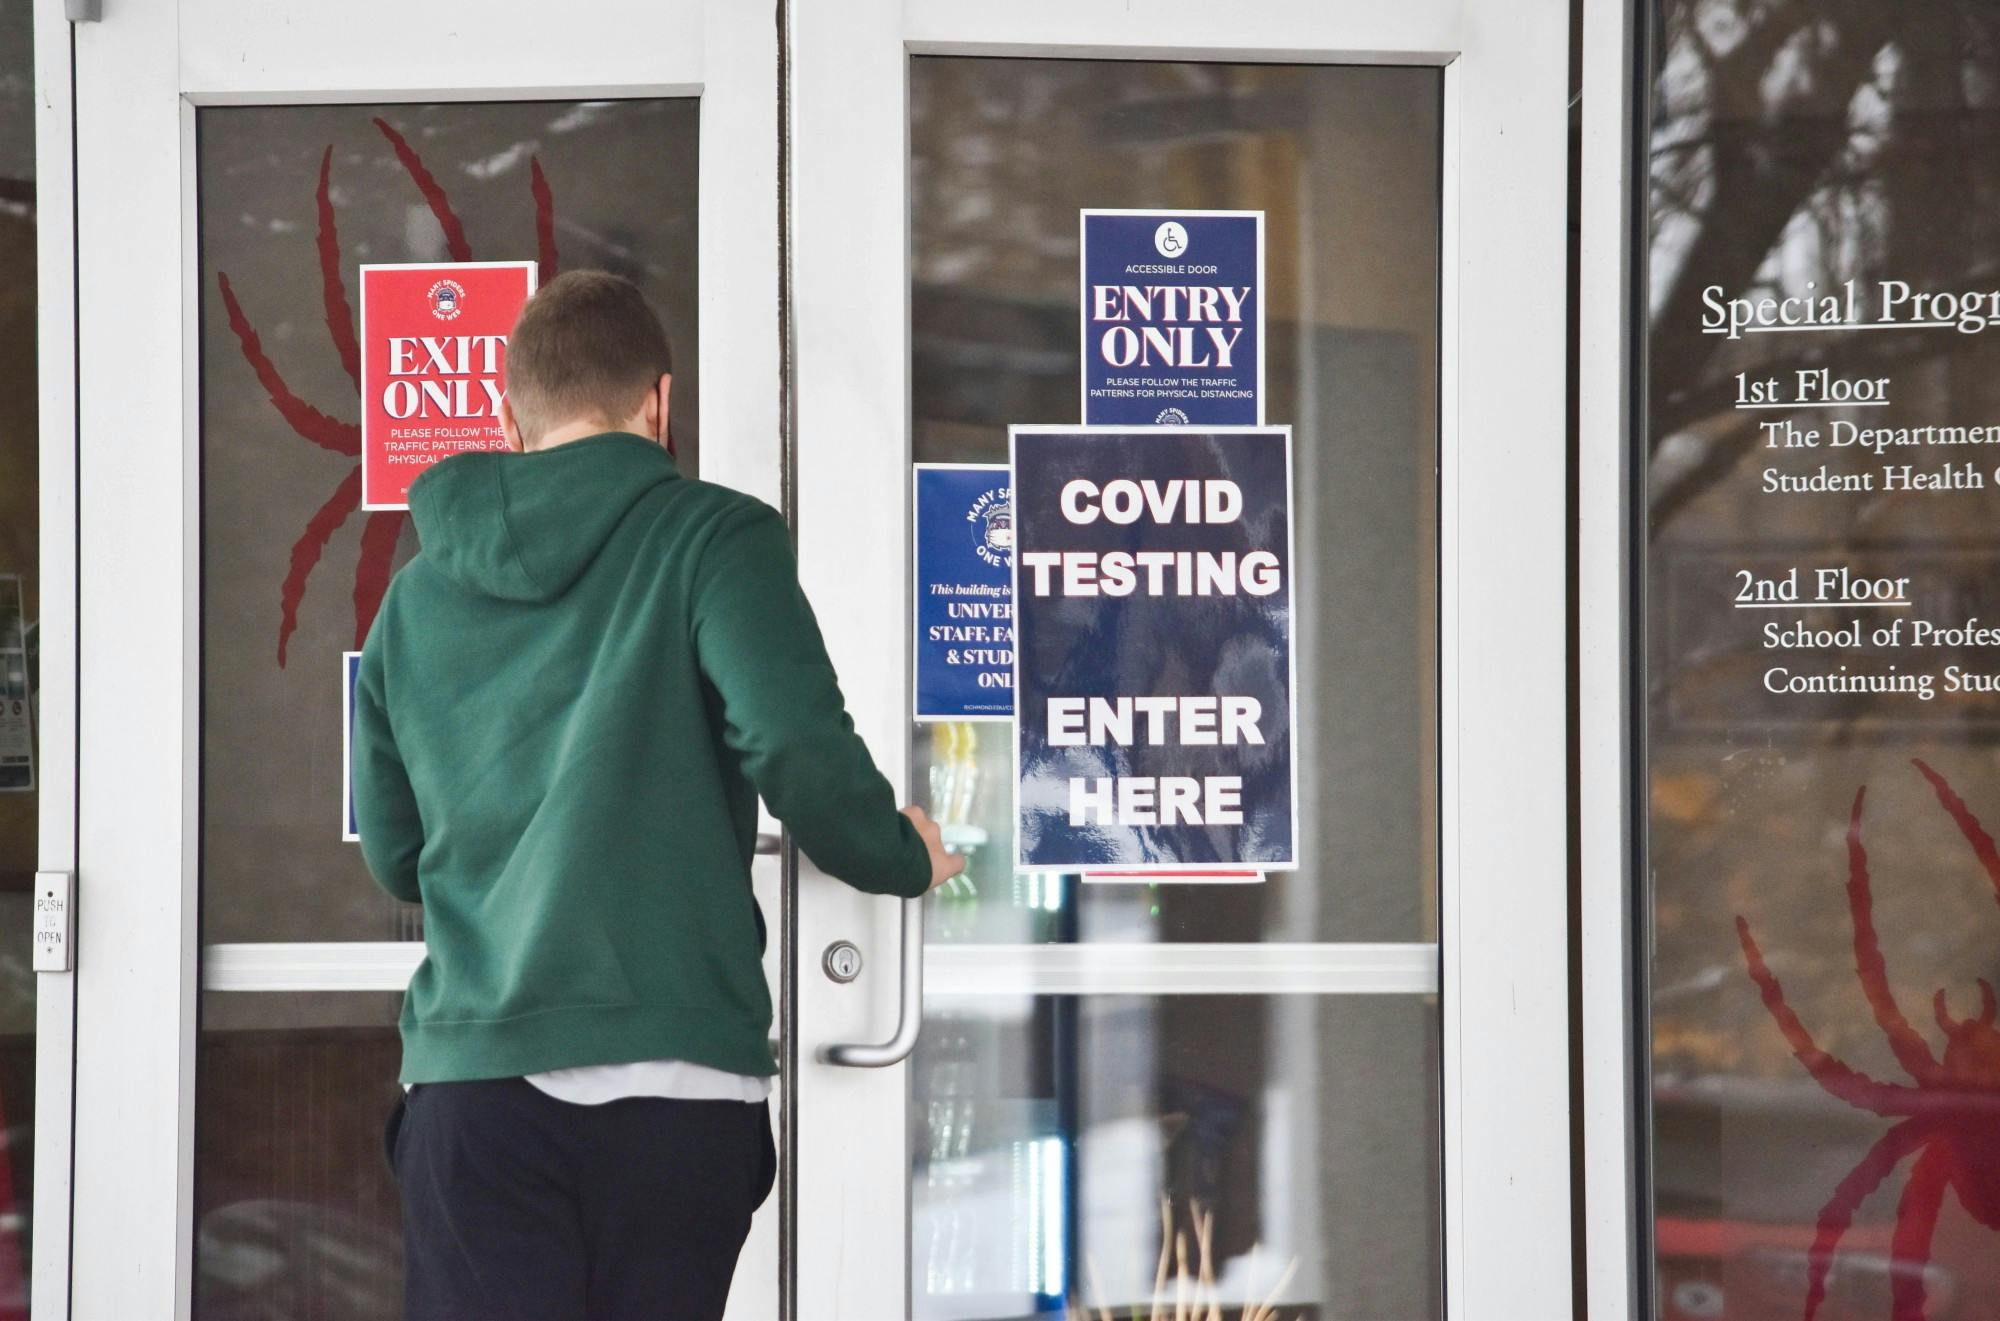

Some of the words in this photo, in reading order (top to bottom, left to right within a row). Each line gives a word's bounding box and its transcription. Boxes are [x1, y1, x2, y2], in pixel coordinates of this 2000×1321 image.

[1125, 265, 1185, 274] ACCESSIBLE
[1188, 265, 1218, 274] DOOR
[432, 309, 446, 321] ONE
[1093, 285, 1251, 322] ENTRY
[1702, 280, 1858, 339] Special
[388, 335, 508, 375] EXIT
[1101, 326, 1243, 368] ONLY
[383, 378, 507, 418] ONLY
[1090, 389, 1134, 397] PATTERNS
[1136, 389, 1155, 398] FOR
[1156, 389, 1199, 398] PHYSICAL
[1200, 389, 1254, 398] DISTANCING
[1106, 378, 1139, 386] PLEASE
[1141, 378, 1179, 386] FOLLOW
[1181, 378, 1199, 387] THE
[1200, 378, 1237, 387] TRAFFIC
[1735, 372, 1779, 403] 1st
[1794, 368, 1890, 402] Floor
[384, 441, 429, 451] TRAFFIC
[432, 440, 486, 450] PATTERNS
[489, 439, 511, 449] FOR
[391, 429, 431, 438] PLEASE
[434, 428, 480, 437] FOLLOW
[484, 427, 505, 437] THE
[1759, 421, 1820, 448] The
[1829, 421, 2000, 454] Departmen
[388, 454, 439, 464] PHYSICAL
[1762, 466, 1873, 493] Student
[1882, 462, 1985, 491] Health
[967, 490, 994, 522] MANY
[1060, 479, 1243, 525] COVID
[976, 545, 1000, 567] ONE
[1022, 551, 1281, 597] TESTING
[1735, 568, 1799, 601] 2nd
[1814, 567, 1910, 600] Floor
[930, 584, 954, 595] This
[955, 584, 1001, 598] building
[1002, 584, 1012, 596] is
[929, 626, 990, 643] STAFF,
[1763, 620, 1862, 648] School
[1872, 618, 1903, 647] of
[1911, 618, 2000, 646] Profes
[947, 649, 960, 664] &
[963, 649, 1014, 665] STUD
[1763, 665, 1934, 700] Continuing
[1047, 696, 1265, 746] ENTER
[1069, 776, 1244, 827] HERE
[37, 899, 64, 912] PUSH
[37, 931, 62, 944] OPEN
